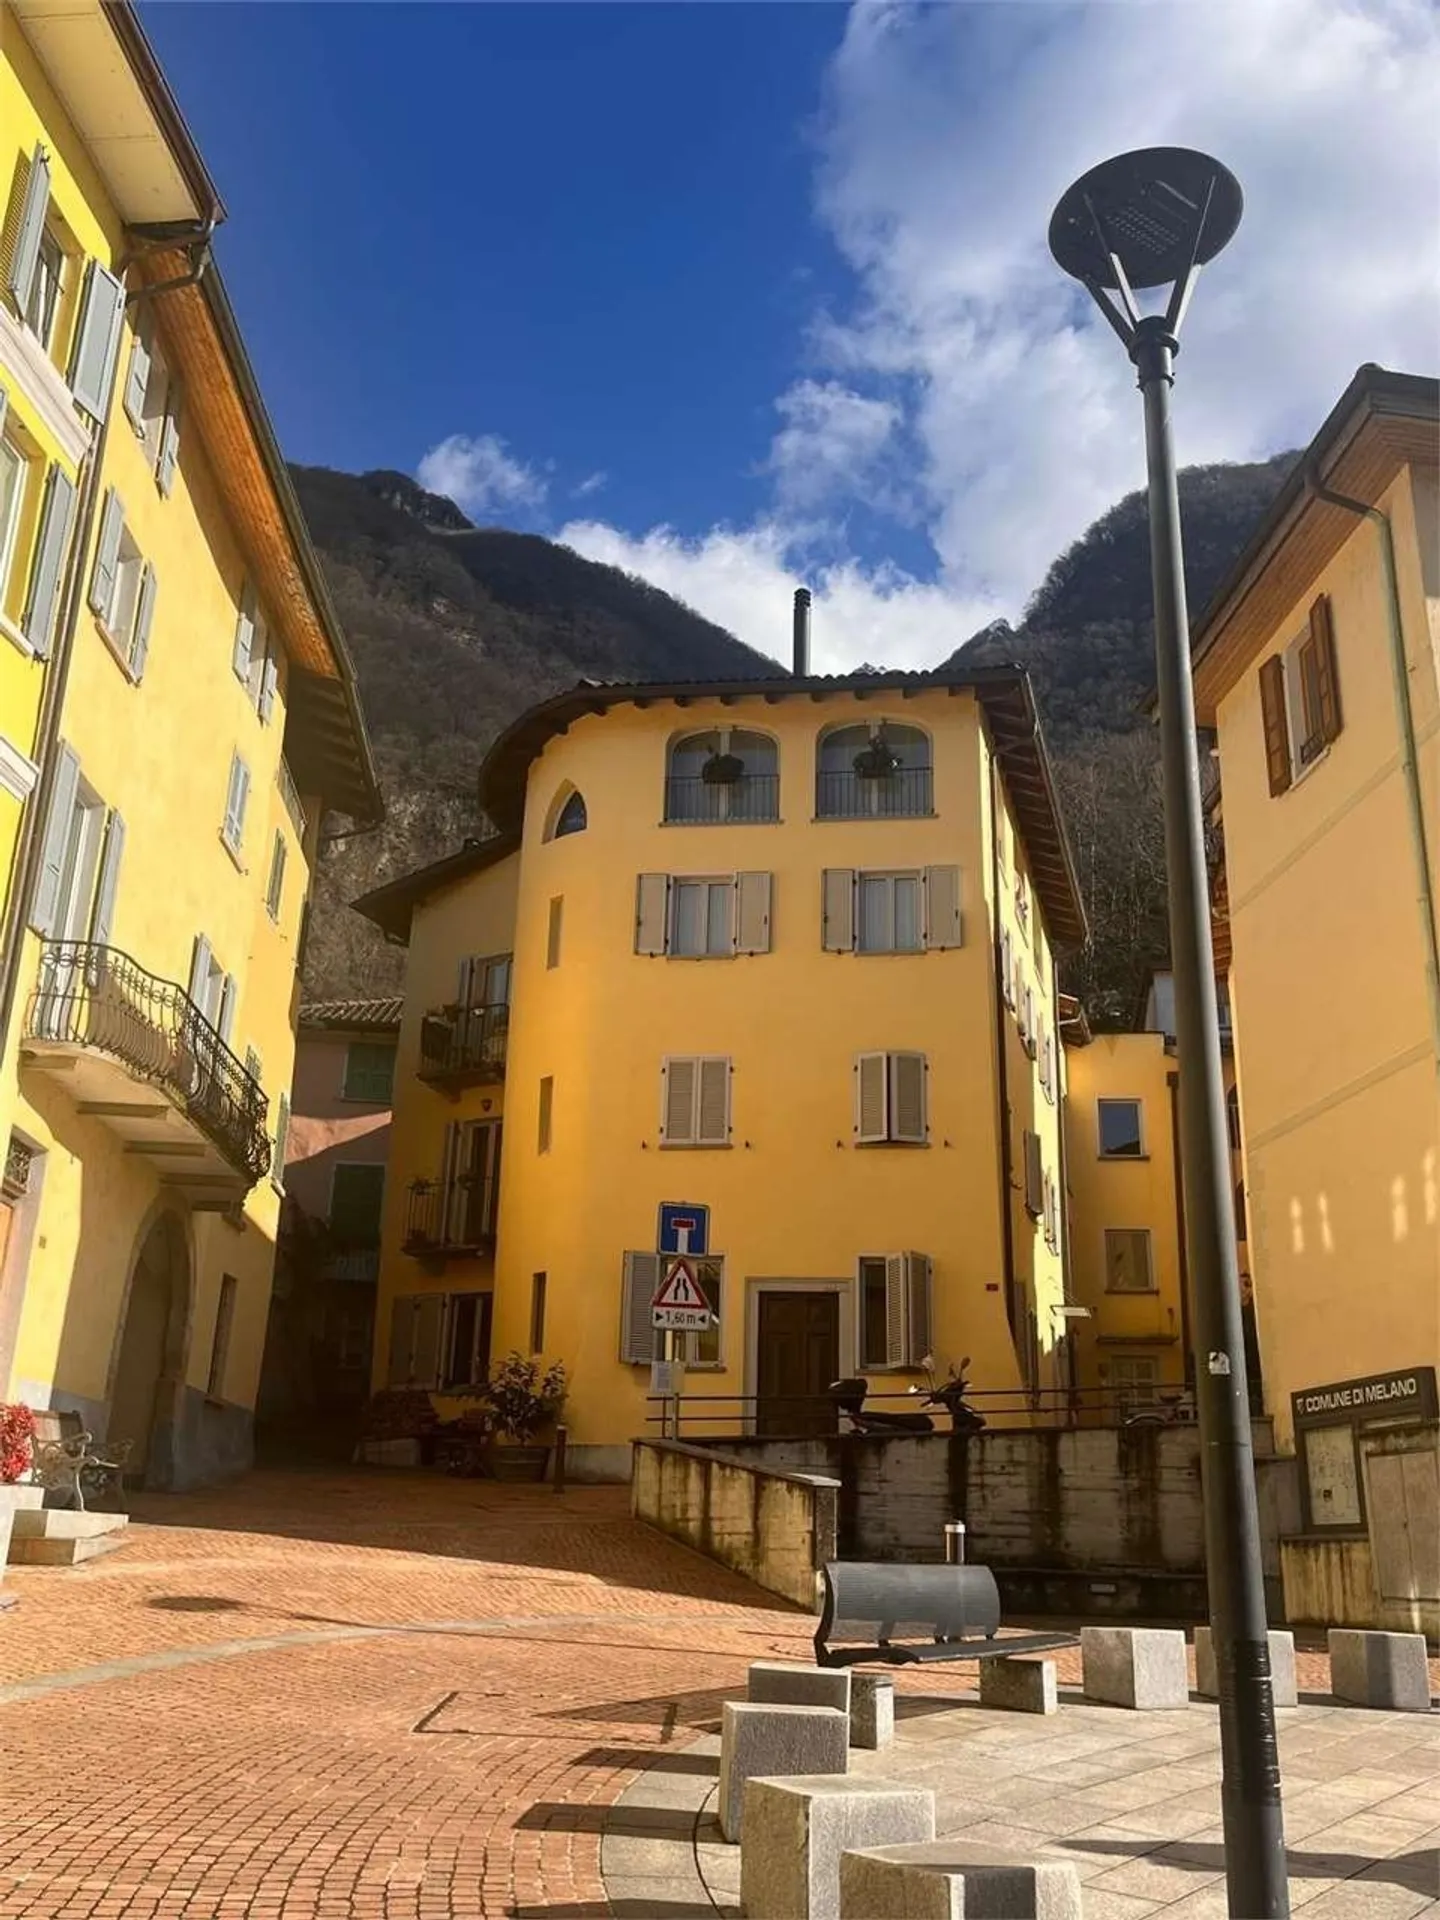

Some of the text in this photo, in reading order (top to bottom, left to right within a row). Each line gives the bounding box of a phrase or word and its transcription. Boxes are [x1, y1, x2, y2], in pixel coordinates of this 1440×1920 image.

[687, 1314, 696, 1324] m
[1306, 1378, 1417, 1412] COMUNE DI MELANO
